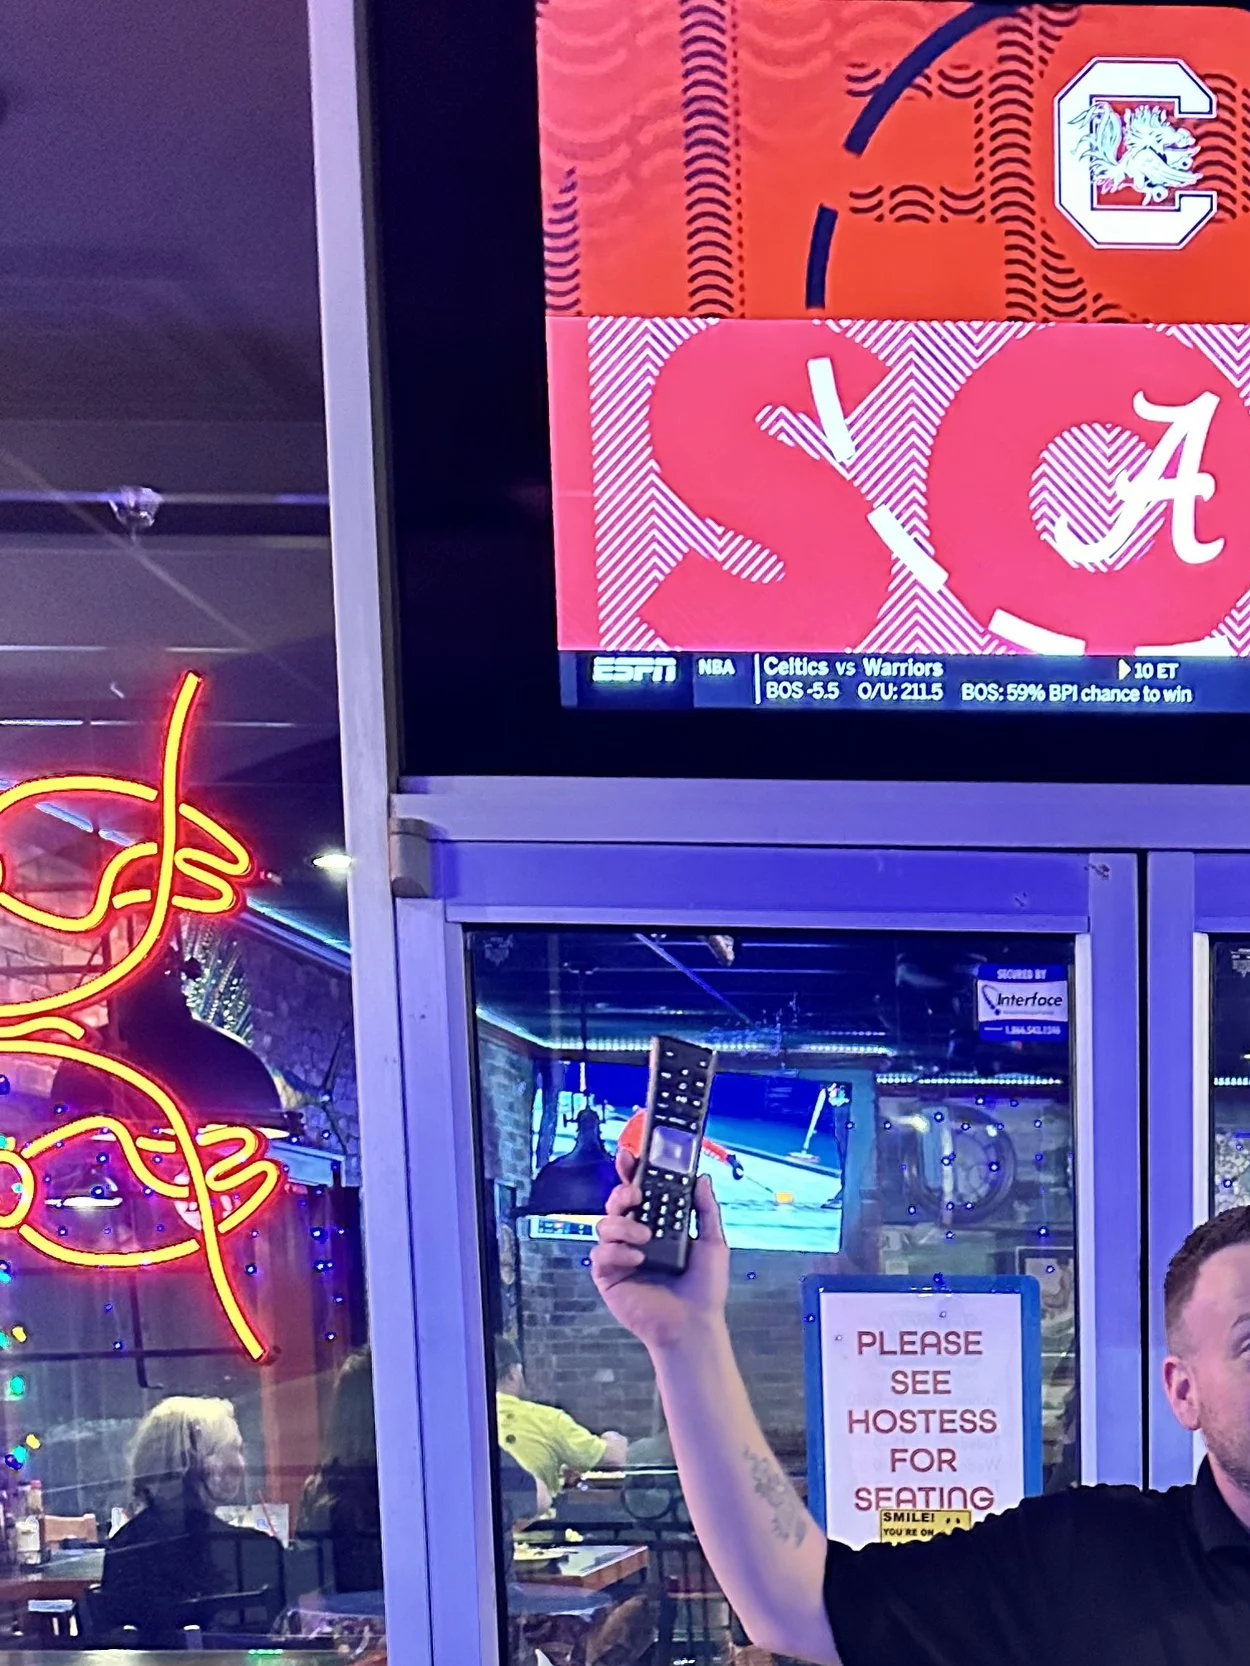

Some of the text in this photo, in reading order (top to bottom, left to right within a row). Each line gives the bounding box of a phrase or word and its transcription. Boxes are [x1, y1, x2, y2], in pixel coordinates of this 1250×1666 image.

[592, 656, 676, 682] ESPN
[698, 659, 735, 675] NBA
[763, 656, 944, 677] Celtics vs Warriors
[1135, 662, 1179, 679] 10 ET
[766, 681, 840, 700] BOS -5.5
[858, 683, 943, 701] O/U: 211.5
[961, 683, 1192, 702] BOS: 59% BPI chance to win
[997, 992, 1063, 1007] Interface
[857, 1331, 983, 1355] PLEASE
[891, 1370, 952, 1395] SEE
[848, 1409, 998, 1434] HOSTESS
[890, 1448, 957, 1473] FOR
[854, 1486, 995, 1511] SEATING
[883, 1512, 935, 1523] SMILE!
[883, 1528, 917, 1537] YOU'RE
